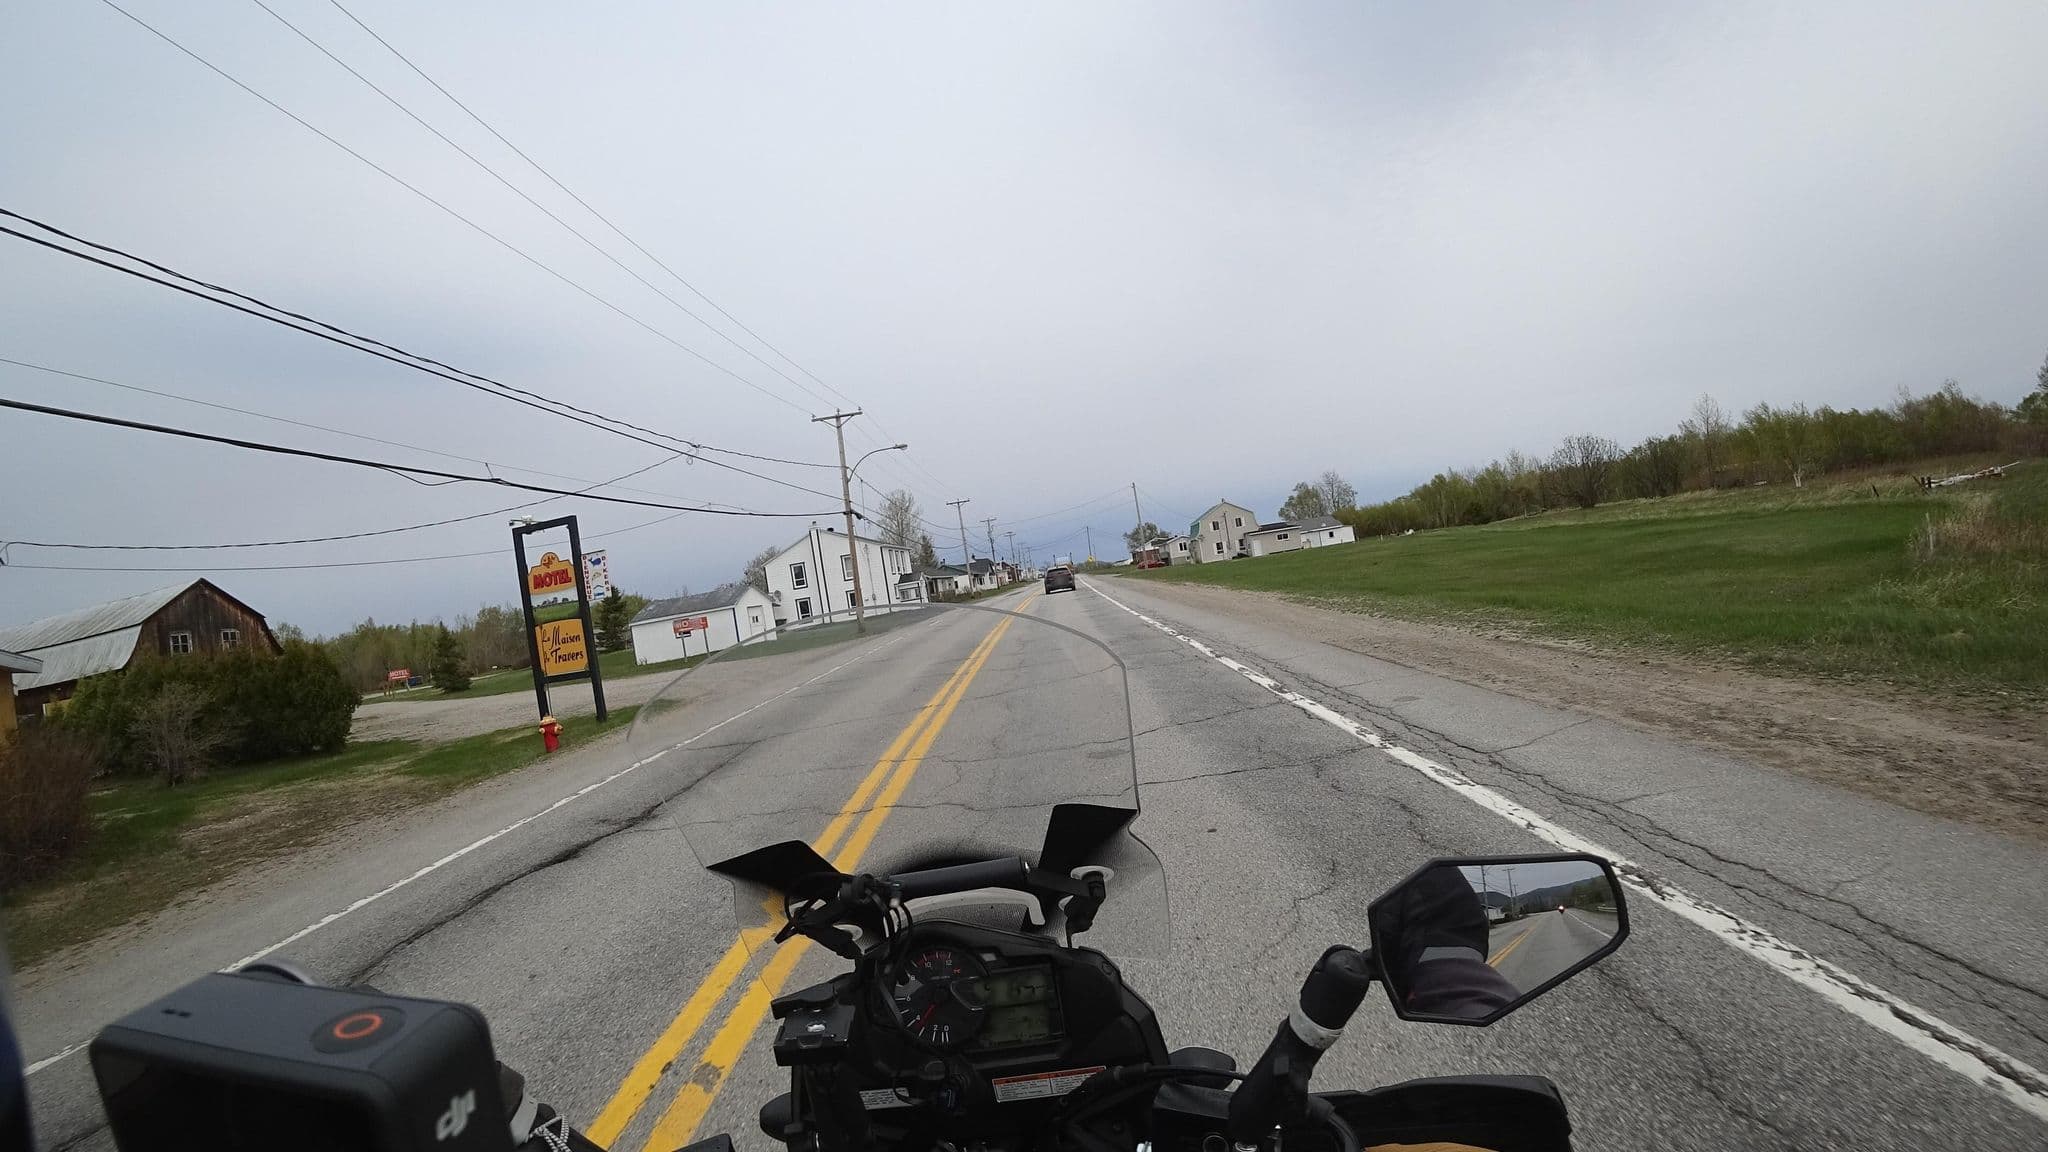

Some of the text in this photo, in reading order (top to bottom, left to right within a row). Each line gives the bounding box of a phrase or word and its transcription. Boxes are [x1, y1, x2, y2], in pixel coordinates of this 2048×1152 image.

[533, 568, 572, 590] MOTEL
[549, 625, 581, 650] Maison
[551, 647, 584, 664] Travers
